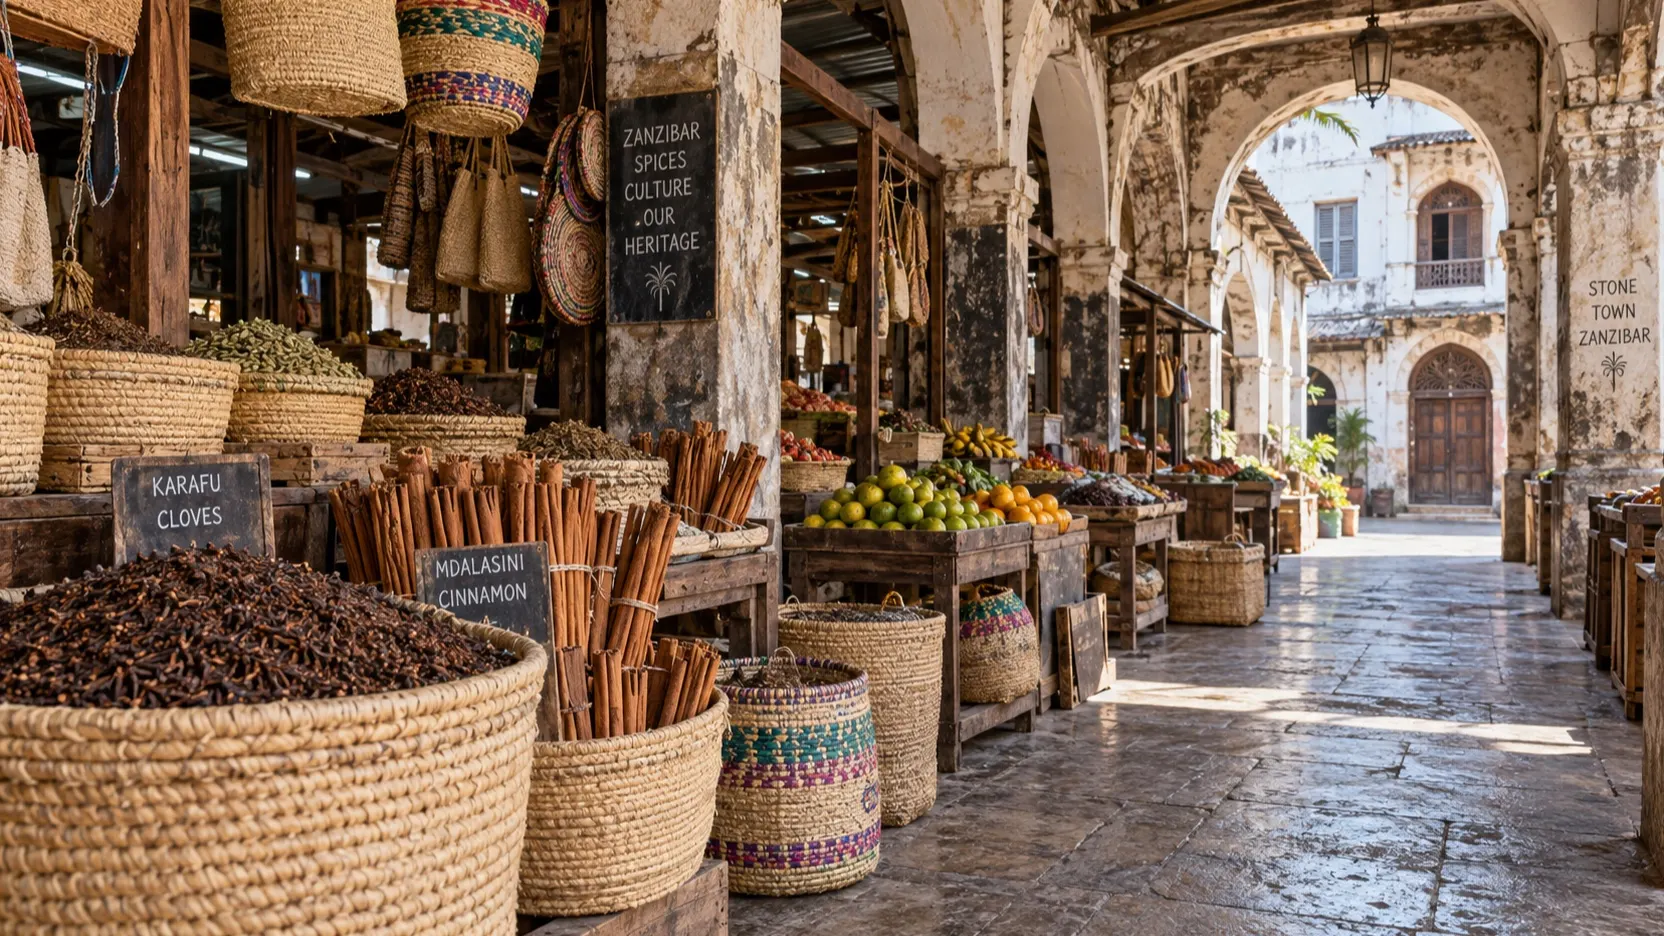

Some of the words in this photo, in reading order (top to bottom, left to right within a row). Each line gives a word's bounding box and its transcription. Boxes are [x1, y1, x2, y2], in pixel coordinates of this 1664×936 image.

[623, 121, 701, 148] ZANZIBAR
[634, 150, 687, 174] SPICES
[624, 177, 692, 202] CULTURE
[643, 206, 676, 227] OUR
[625, 231, 700, 256] HERITAGE
[1588, 278, 1638, 297] STONE
[1591, 303, 1636, 321] TOWN
[1579, 327, 1651, 346] ZANZIBAR
[152, 473, 221, 498] KARAFU
[157, 506, 223, 530] CLOVES
[436, 553, 524, 579] MDALASINI
[438, 582, 527, 609] CINNAMON
